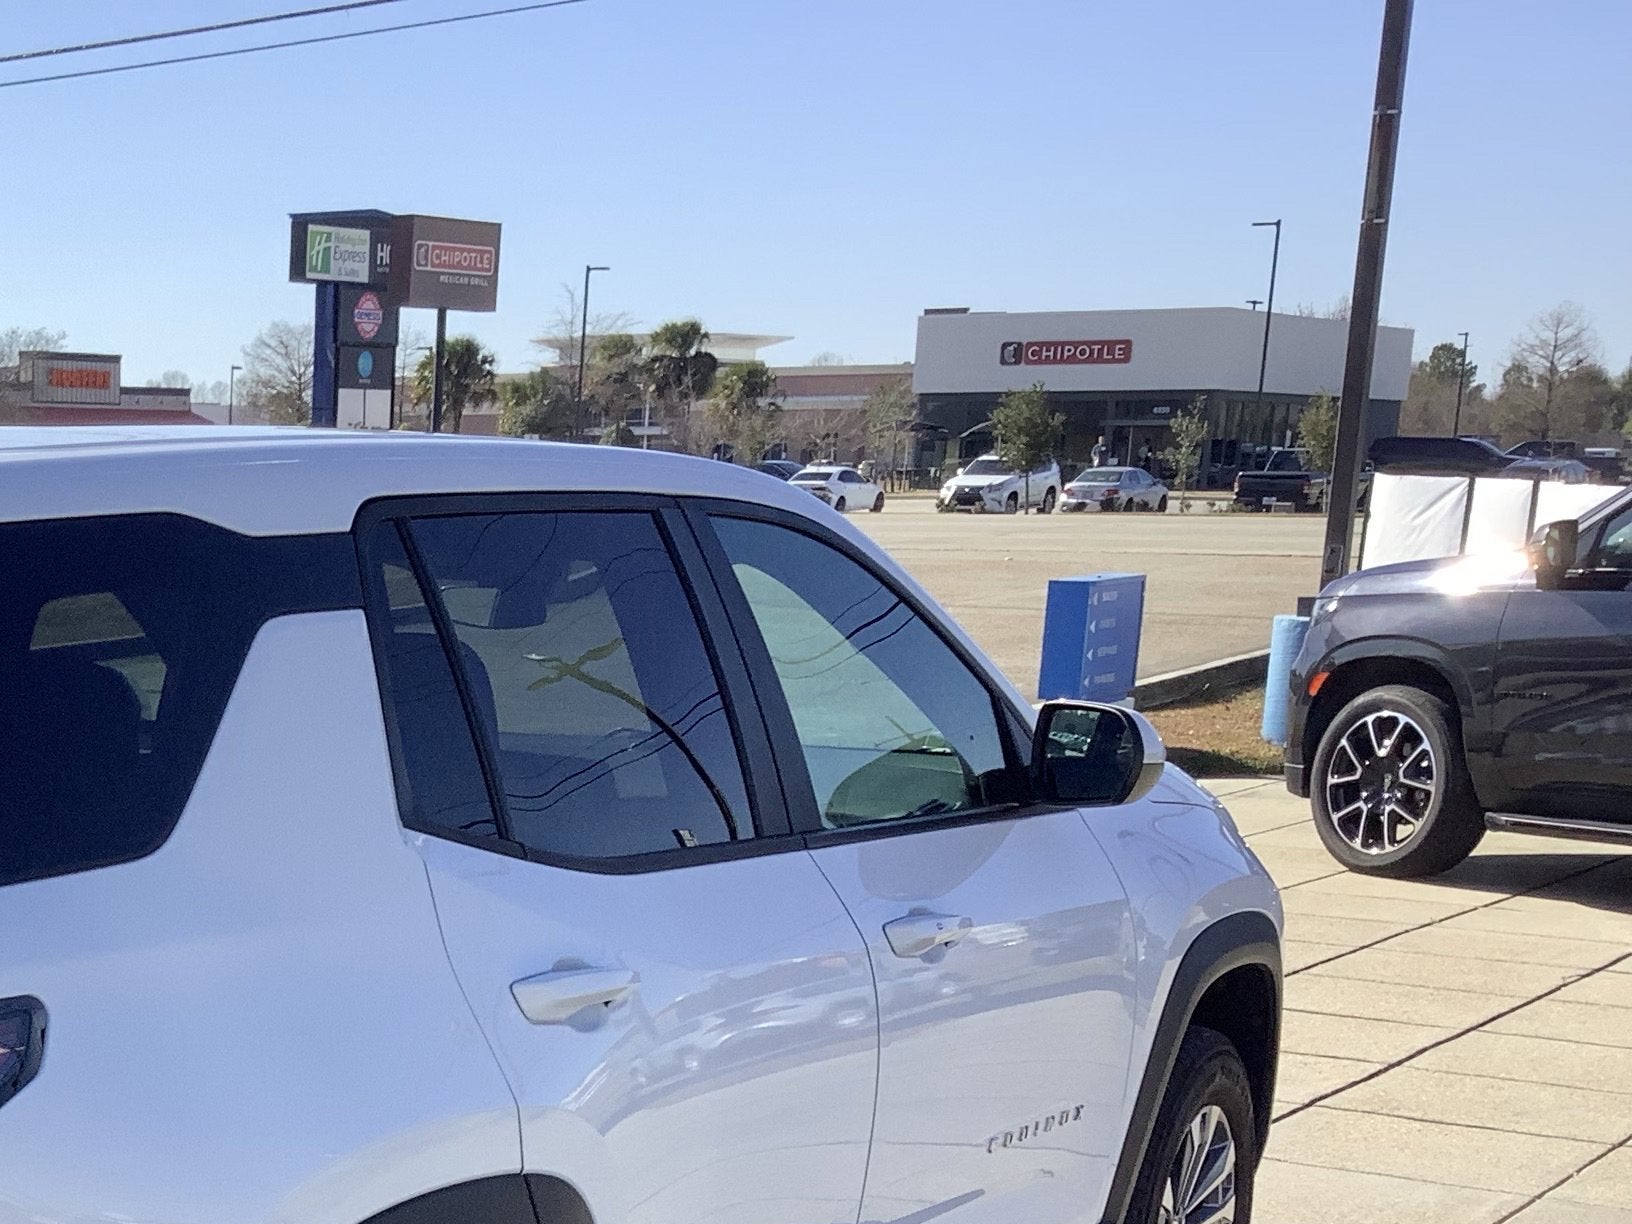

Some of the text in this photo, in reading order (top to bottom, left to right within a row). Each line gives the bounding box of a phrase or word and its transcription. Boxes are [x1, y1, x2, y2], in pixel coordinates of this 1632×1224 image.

[333, 245, 367, 264] Express
[432, 249, 490, 268] CHIPOTLE
[1027, 344, 1126, 360] CHIPOTLE
